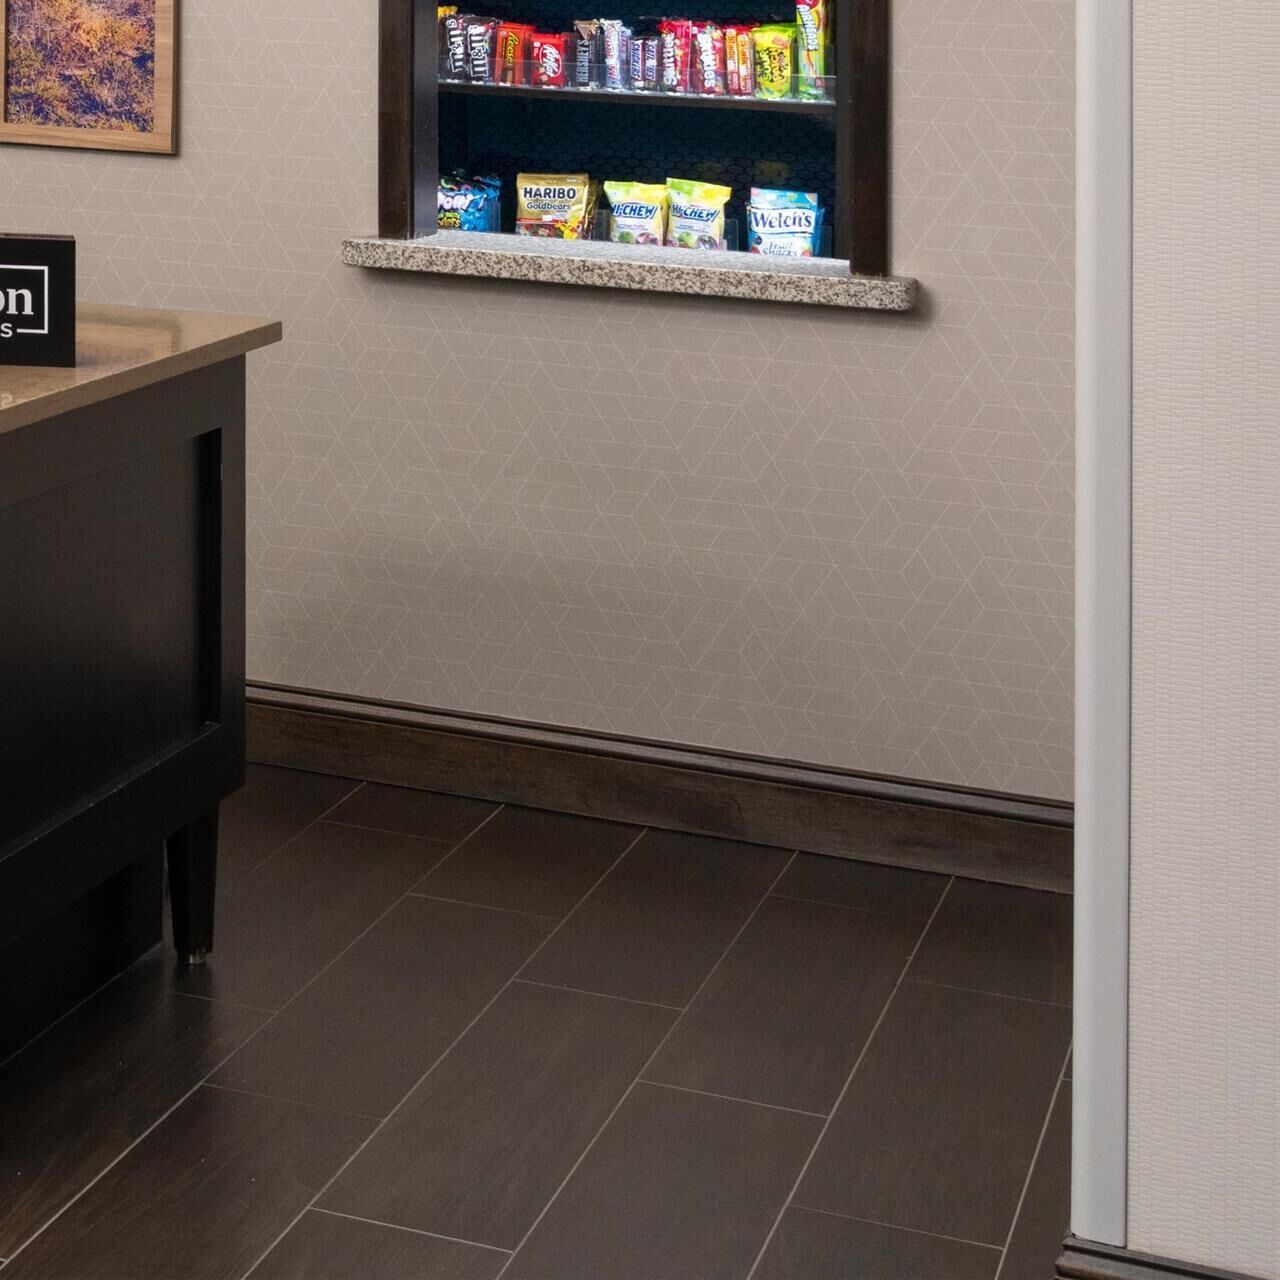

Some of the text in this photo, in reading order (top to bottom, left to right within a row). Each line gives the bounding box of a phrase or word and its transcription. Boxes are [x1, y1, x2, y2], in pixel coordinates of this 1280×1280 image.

[796, 4, 819, 51] AIRHEADS
[523, 187, 576, 200] HARIBO
[526, 202, 572, 210] Goldbears
[751, 211, 813, 229] Welch's
